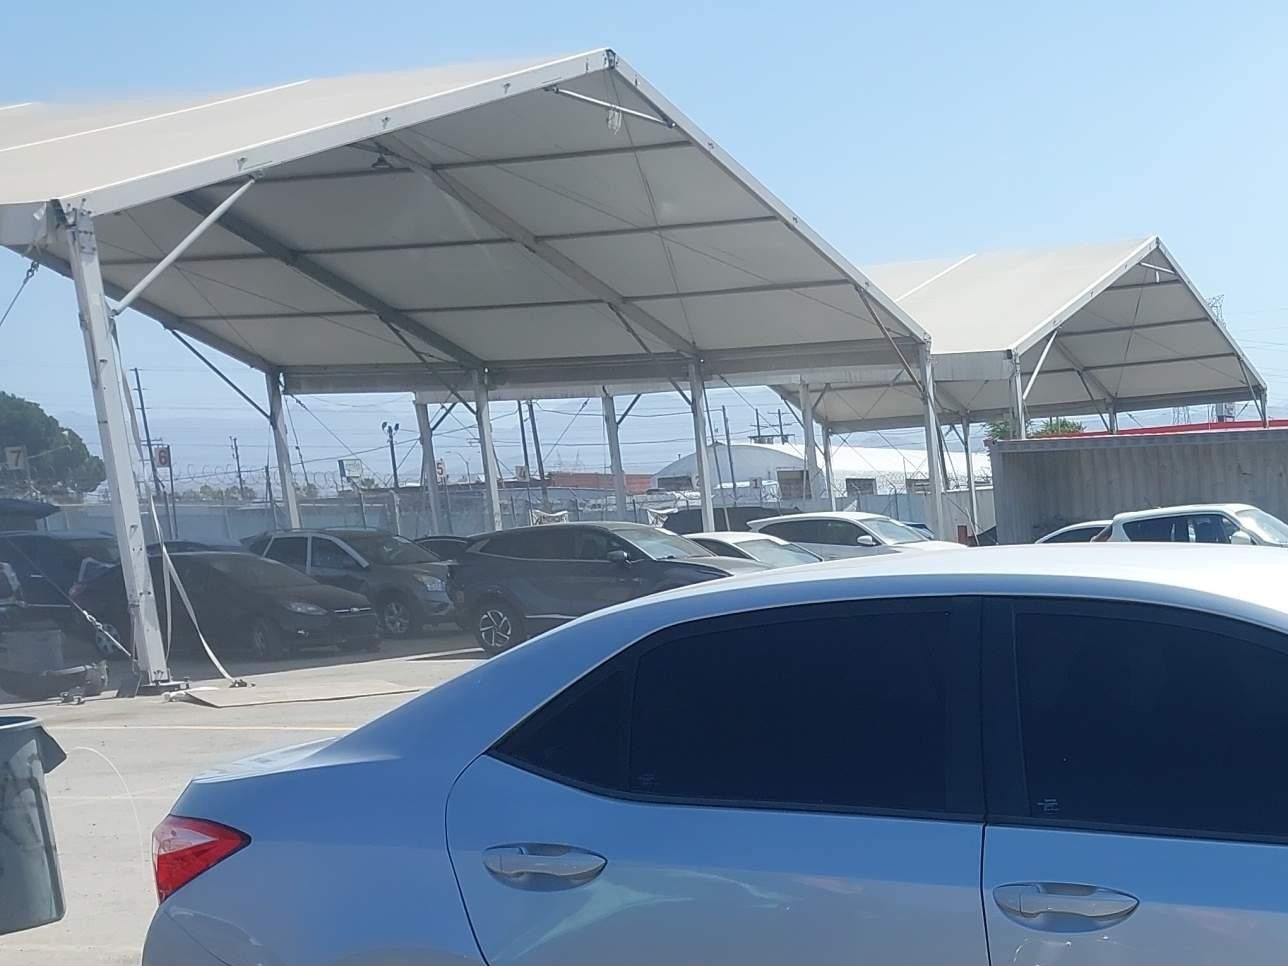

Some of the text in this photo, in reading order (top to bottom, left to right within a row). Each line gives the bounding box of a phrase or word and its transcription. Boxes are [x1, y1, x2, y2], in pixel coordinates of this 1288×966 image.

[10, 450, 22, 467] 7
[158, 449, 168, 465] 6
[436, 462, 444, 476] 5
